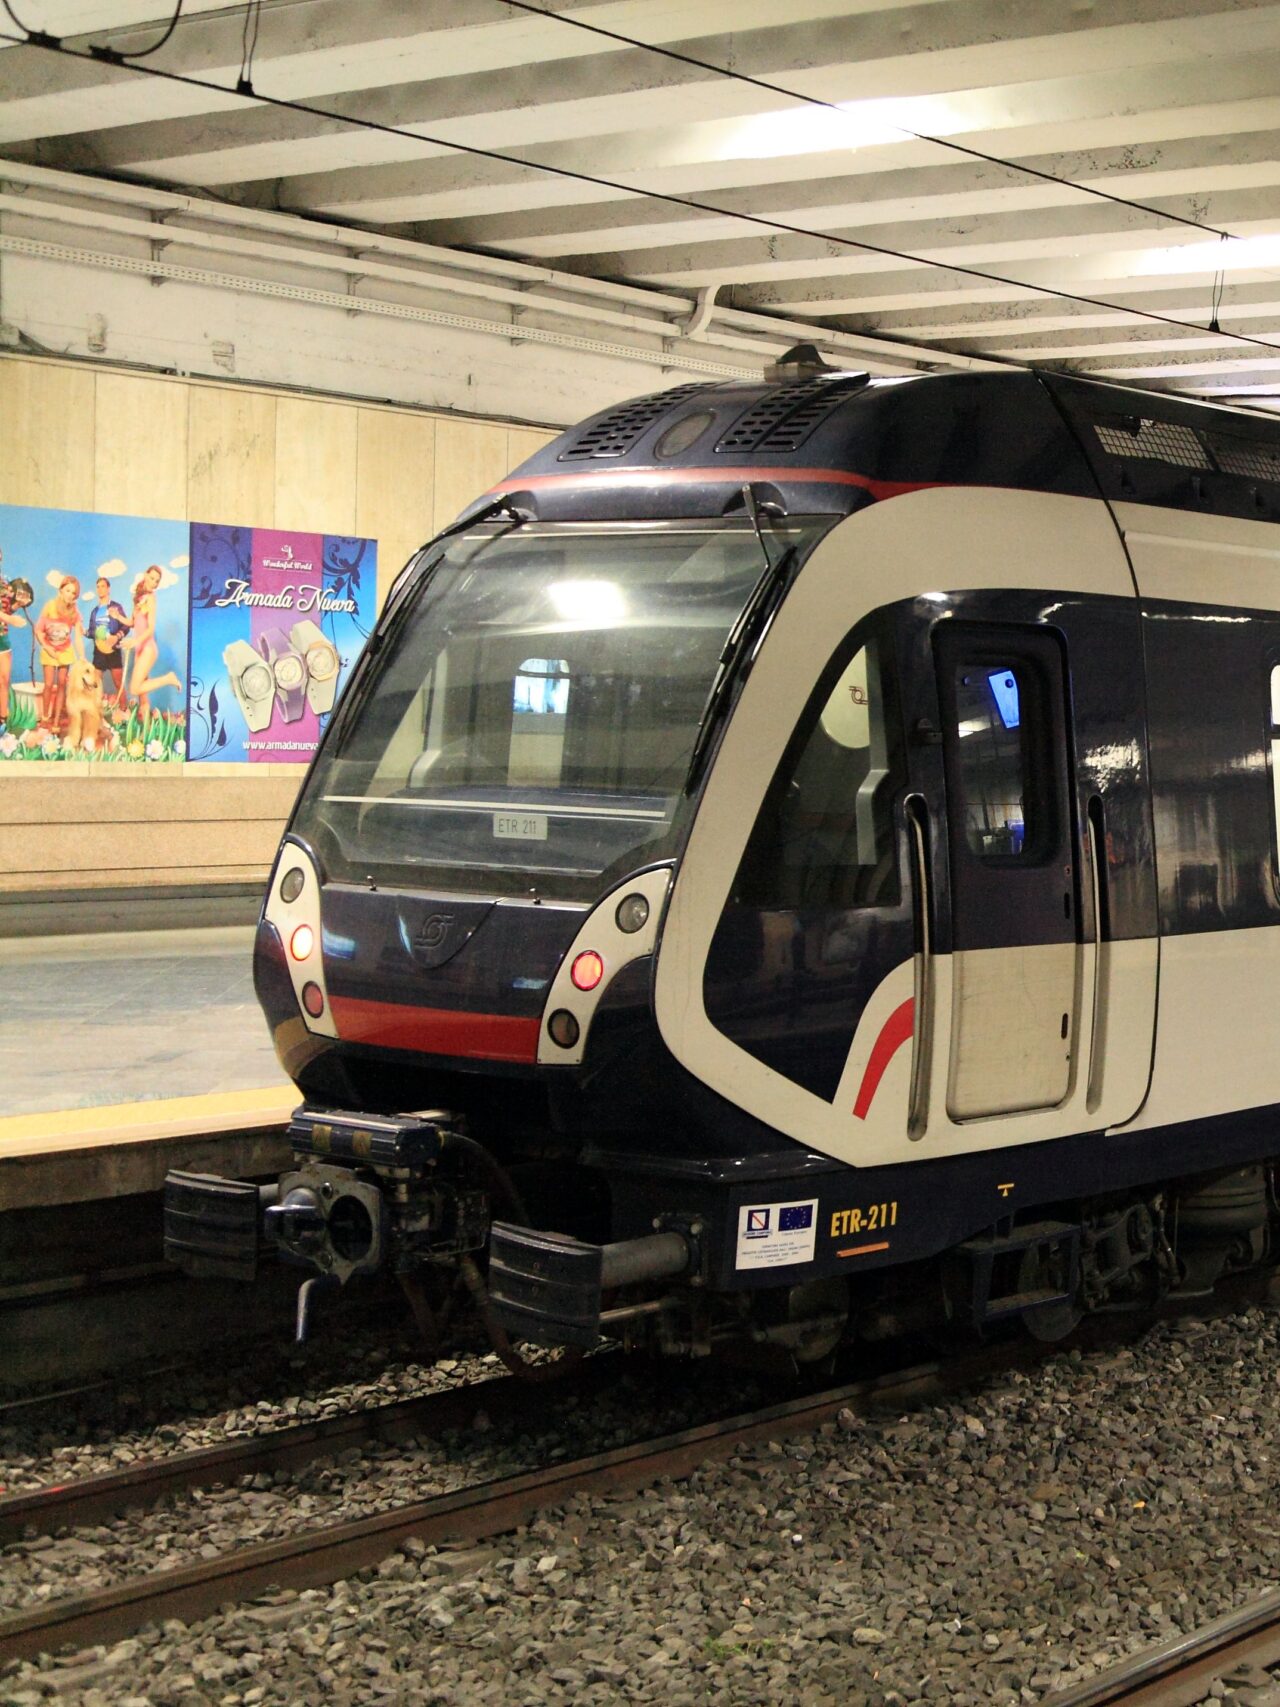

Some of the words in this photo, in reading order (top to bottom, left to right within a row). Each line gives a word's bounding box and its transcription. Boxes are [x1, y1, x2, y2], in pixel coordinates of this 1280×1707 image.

[215, 579, 294, 608] Armada
[297, 584, 355, 613] Nueva
[498, 818, 518, 833] ETR
[523, 820, 537, 835] 211
[830, 1201, 898, 1238] ETR-211
